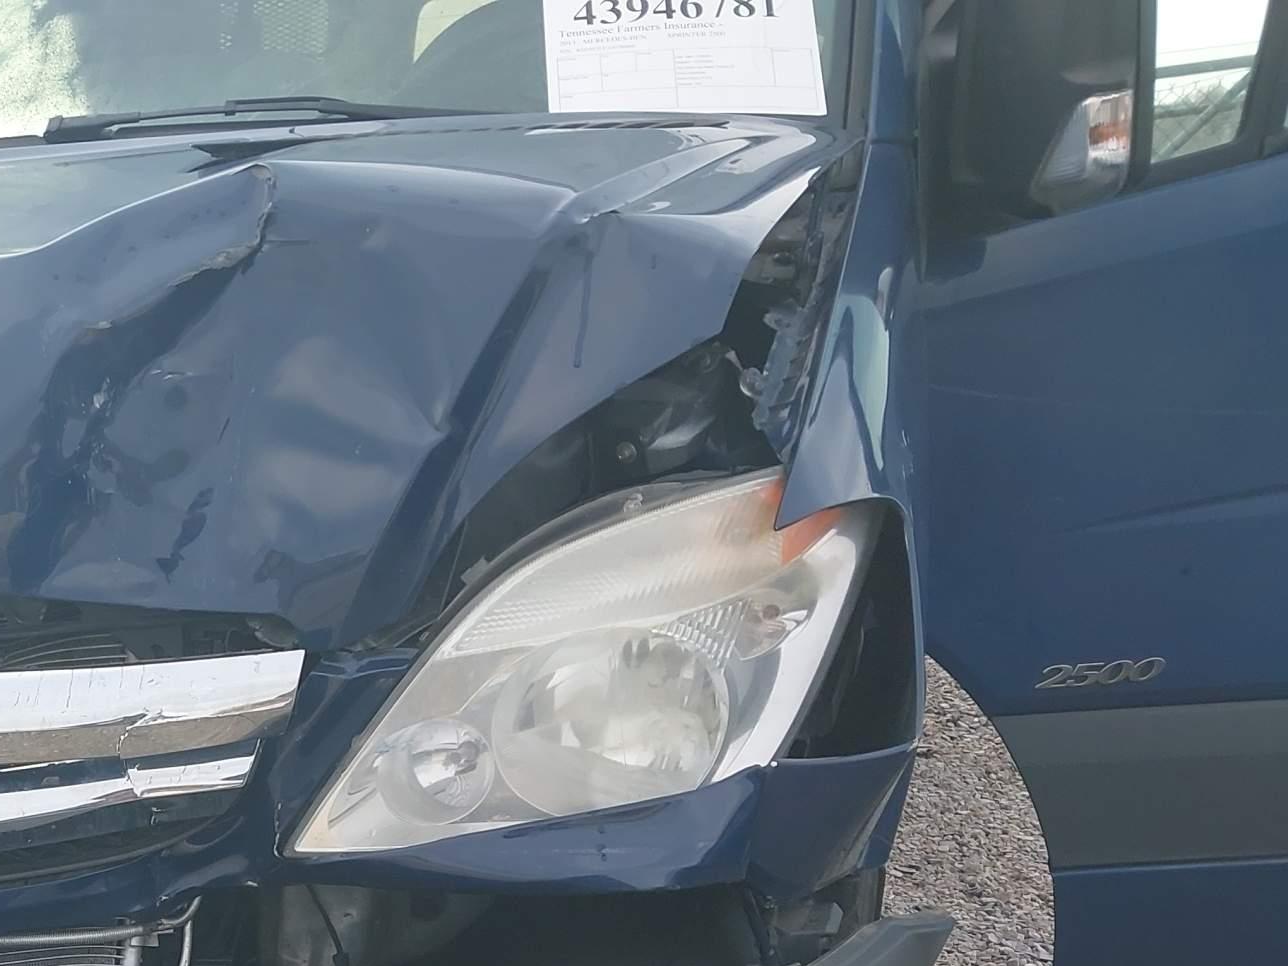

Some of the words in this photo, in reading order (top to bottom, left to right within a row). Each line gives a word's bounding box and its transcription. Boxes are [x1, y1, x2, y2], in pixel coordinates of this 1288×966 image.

[573, 0, 779, 25] 43946781
[559, 27, 613, 39] Tennessee
[616, 22, 661, 33] Farmers
[663, 21, 716, 31] Insurance
[1034, 656, 1167, 689] 2500
